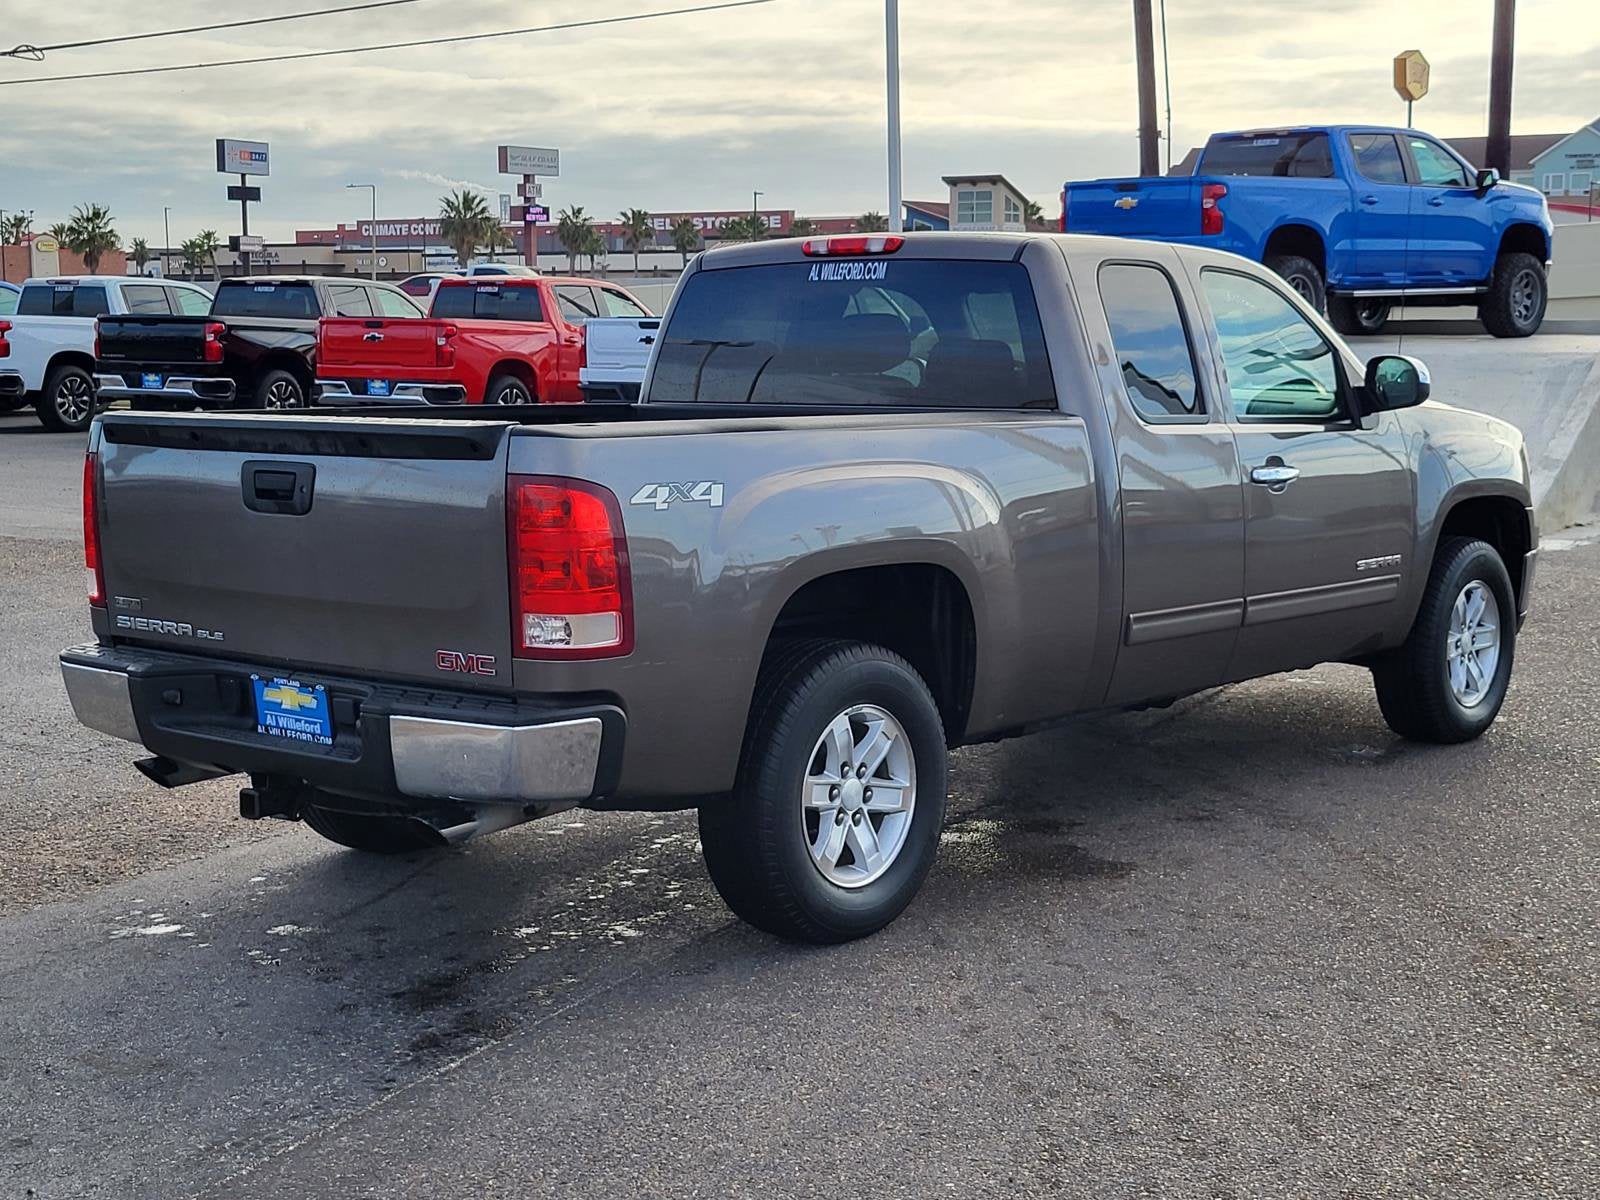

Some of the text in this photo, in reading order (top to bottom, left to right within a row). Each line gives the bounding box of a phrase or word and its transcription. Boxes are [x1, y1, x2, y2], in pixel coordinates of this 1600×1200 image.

[527, 185, 542, 195] ATM
[362, 224, 409, 236] CLIMATE
[808, 261, 888, 281] AL WILLEFORD.COM
[1356, 554, 1401, 571] SIERRA
[116, 615, 225, 641] SIERRA SLE
[436, 649, 496, 676] GMC
[273, 677, 300, 687] PORTLAND
[257, 724, 267, 734] AL
[266, 714, 321, 734] Al Willeford
